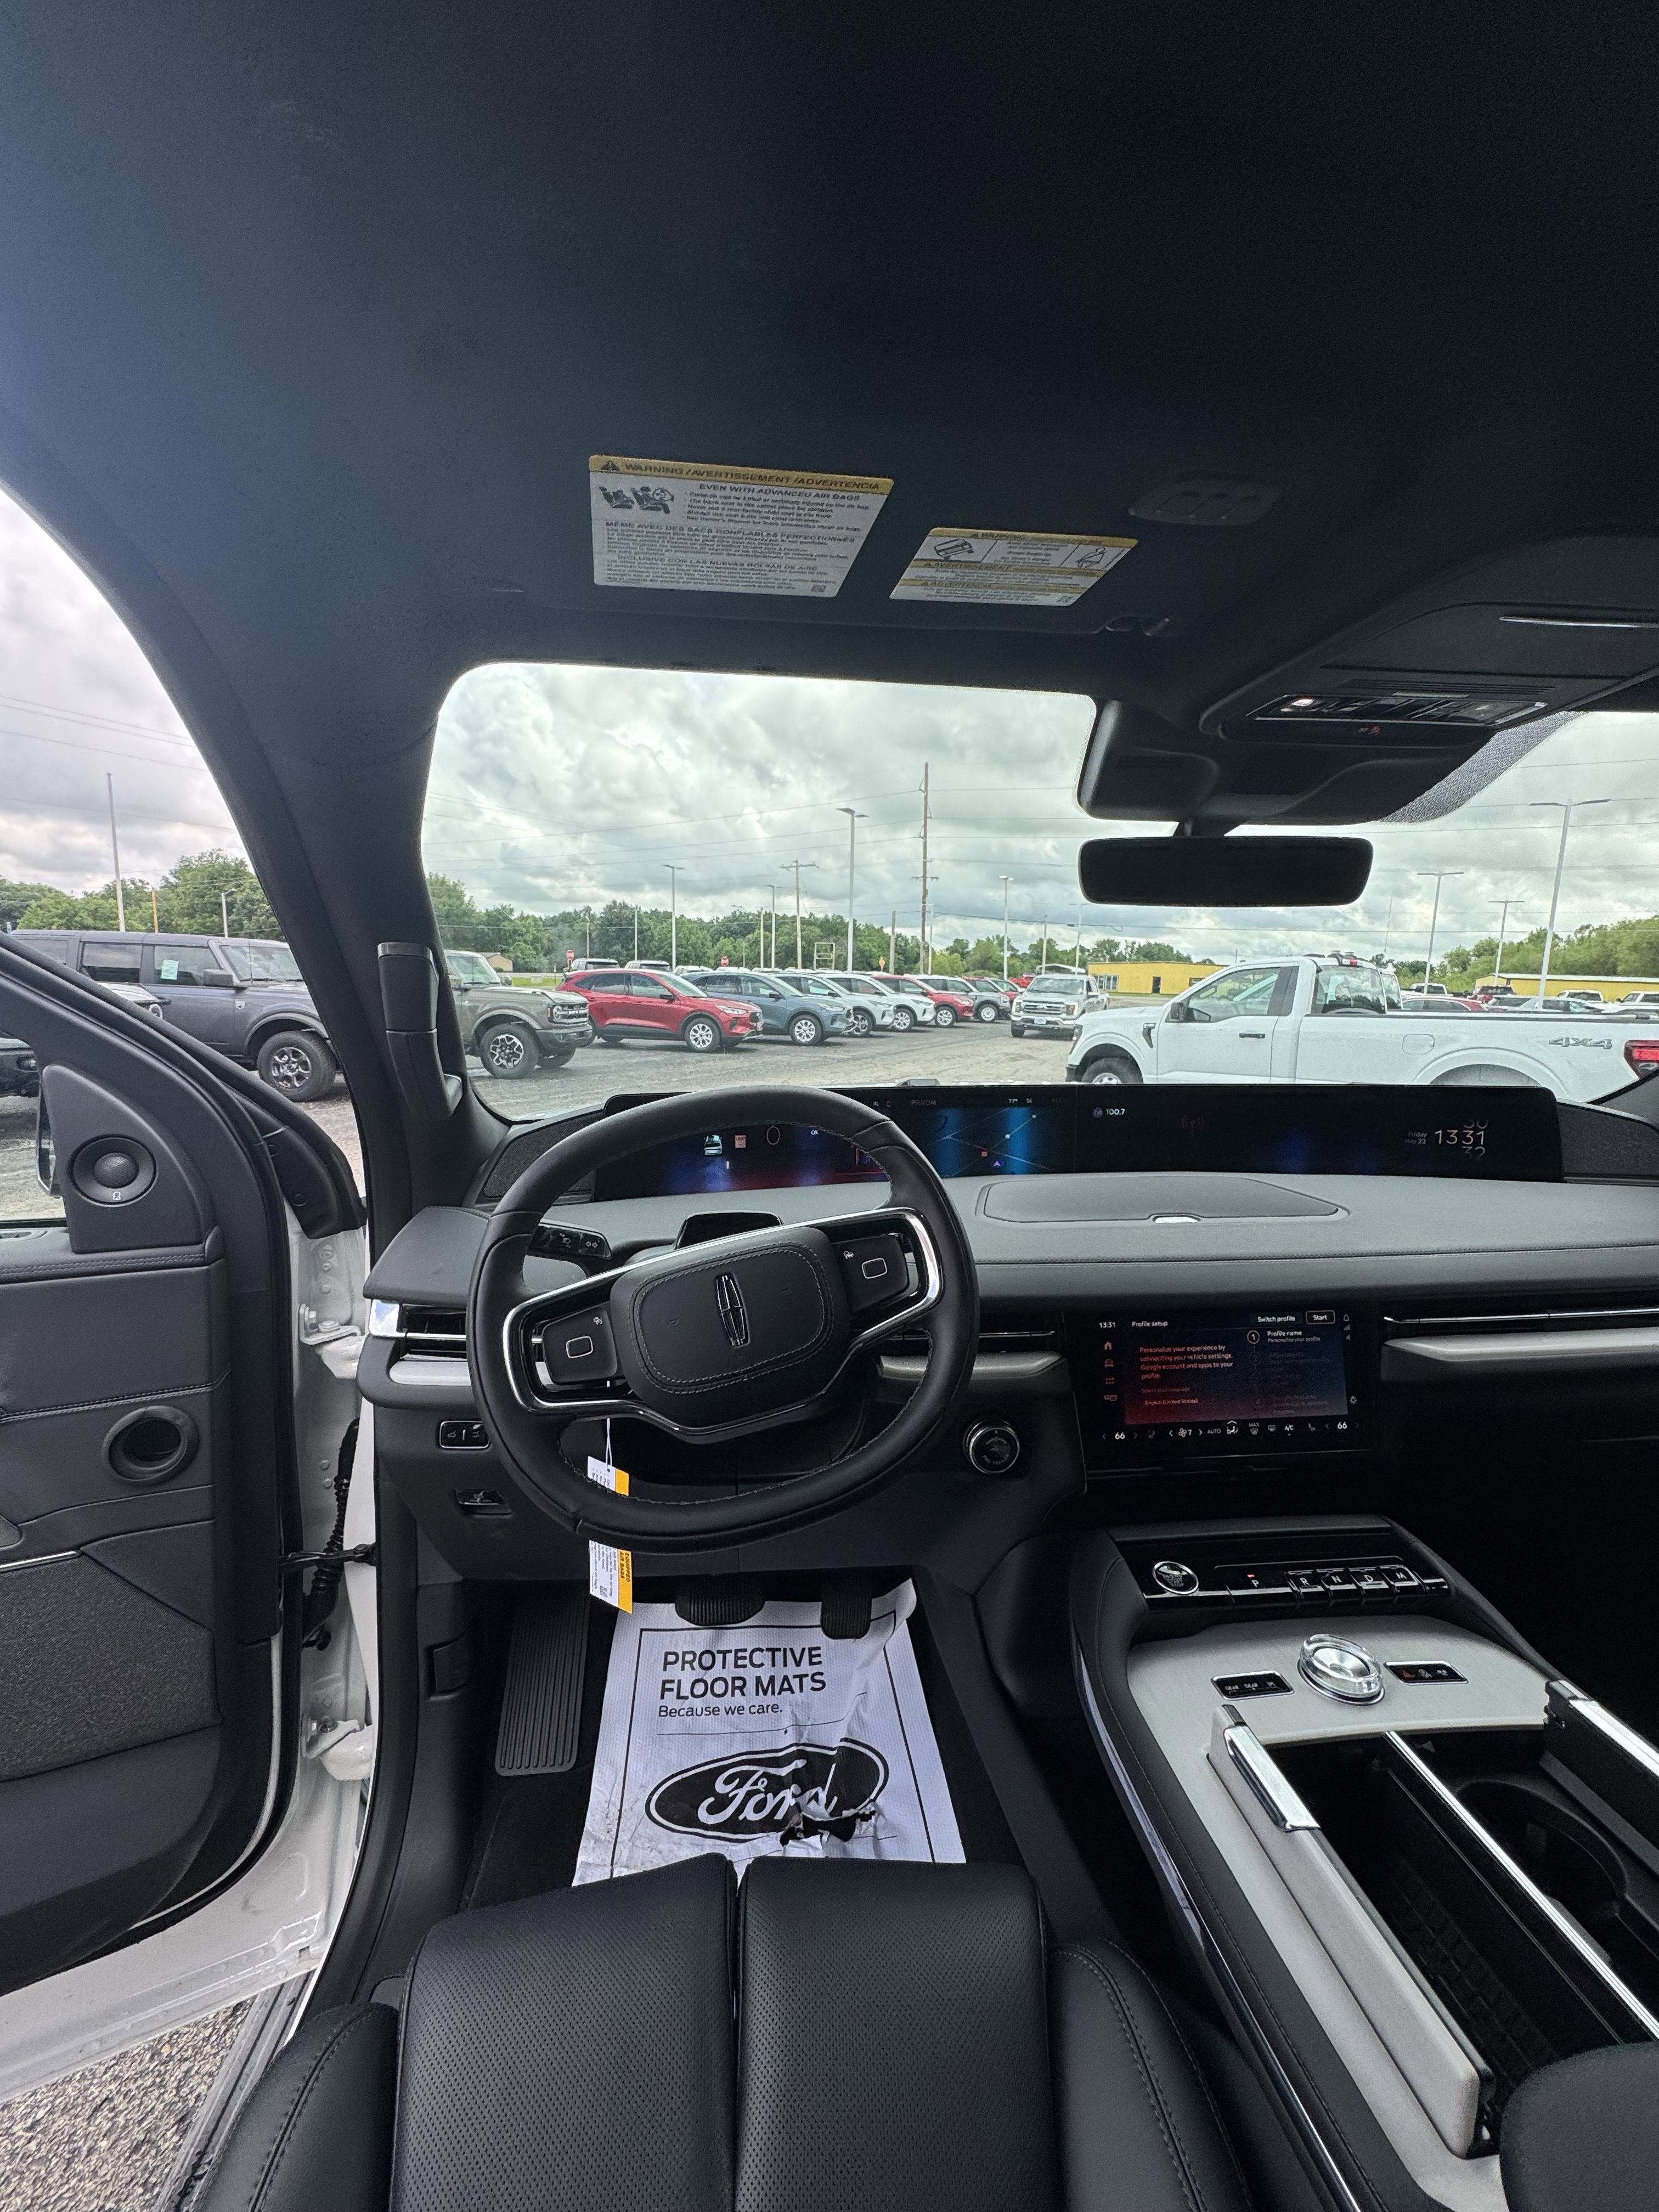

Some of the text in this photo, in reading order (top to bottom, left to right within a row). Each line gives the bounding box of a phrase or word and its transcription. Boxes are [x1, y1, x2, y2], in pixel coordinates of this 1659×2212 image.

[625, 463, 684, 475] WARNING
[757, 488, 812, 497] ADVANCED
[1251, 1579, 1259, 1588] P
[1300, 1577, 1310, 1585] R
[1334, 1575, 1342, 1583] N
[1364, 1574, 1373, 1582] D
[662, 1646, 822, 1672] PROTECTIVE
[660, 1671, 826, 1700] FLOOR MATS
[658, 1703, 783, 1717] Because we care.
[698, 1759, 838, 1825] Ford
